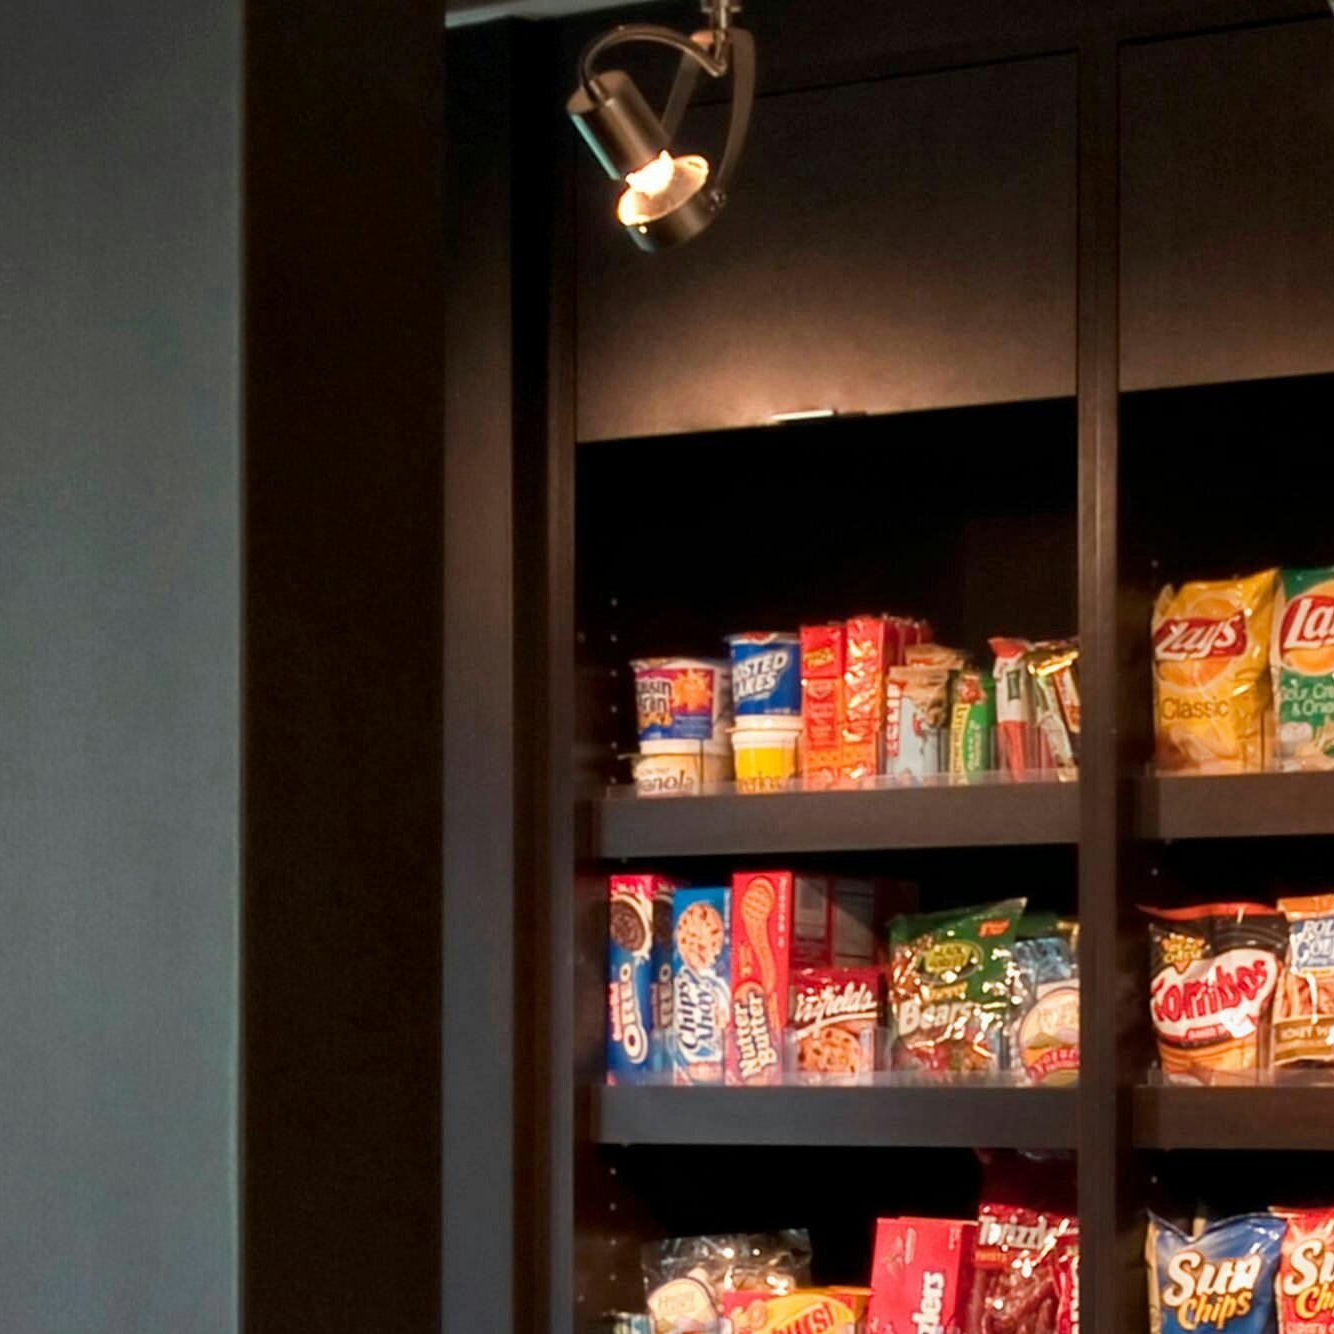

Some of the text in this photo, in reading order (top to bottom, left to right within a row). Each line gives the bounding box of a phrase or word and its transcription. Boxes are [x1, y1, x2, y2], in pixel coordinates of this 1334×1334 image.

[1161, 697, 1230, 721] Classic
[619, 962, 645, 1063] OREO
[679, 978, 698, 1050] Chips
[734, 1001, 759, 1078] Nutter
[748, 989, 777, 1066] Butter
[899, 1001, 972, 1035] Bears
[1163, 1249, 1262, 1308] Sun
[1177, 1290, 1253, 1331] Chips
